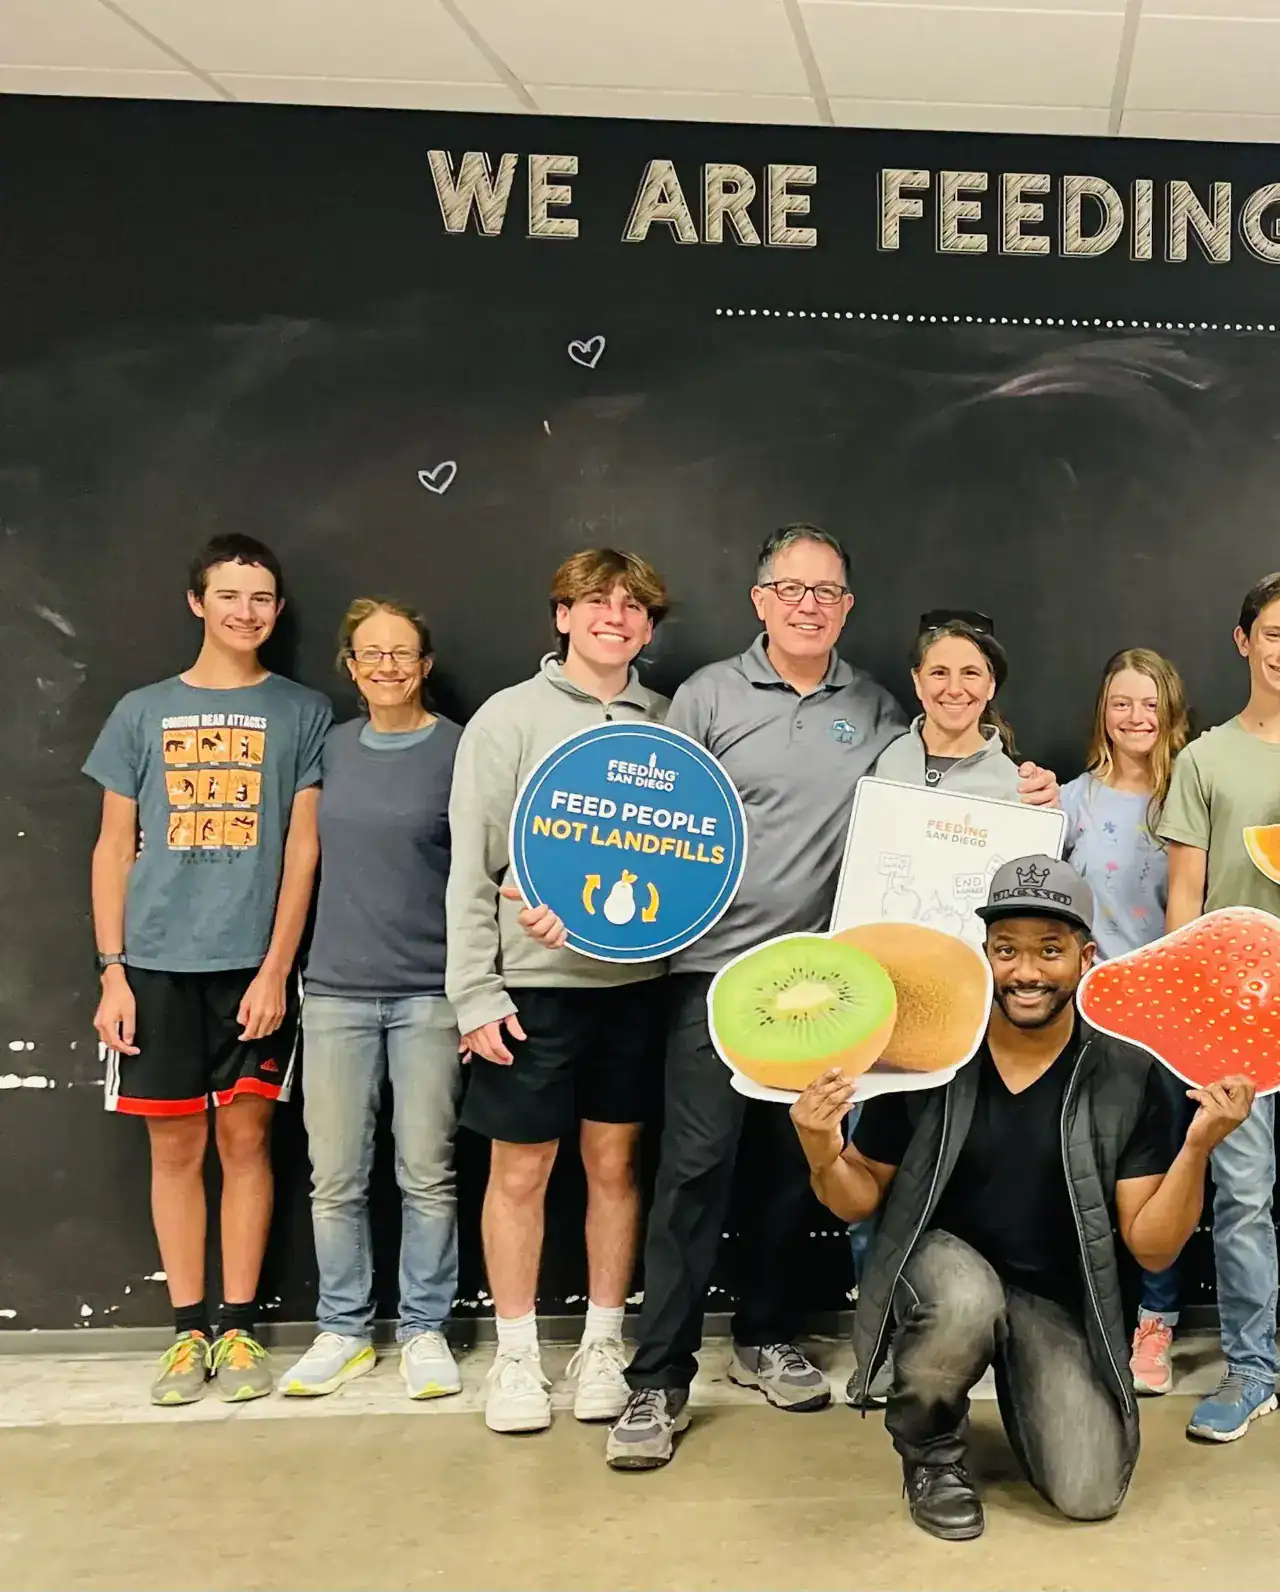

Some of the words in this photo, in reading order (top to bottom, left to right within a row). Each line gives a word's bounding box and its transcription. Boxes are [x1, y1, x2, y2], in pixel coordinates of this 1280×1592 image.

[427, 149, 580, 238] WE
[621, 159, 818, 248] ARE
[606, 771, 633, 785] SAN
[634, 776, 674, 792] DIEGO
[607, 759, 677, 782] FEEDING
[550, 790, 617, 820] FEED
[621, 802, 718, 837] PEOPLE
[532, 815, 588, 843] NOT
[591, 824, 726, 865] LANDFILLS
[925, 830, 949, 842] SAN
[951, 834, 987, 848] DIEGO
[926, 819, 988, 839] FEEDING
[955, 876, 982, 888] END
